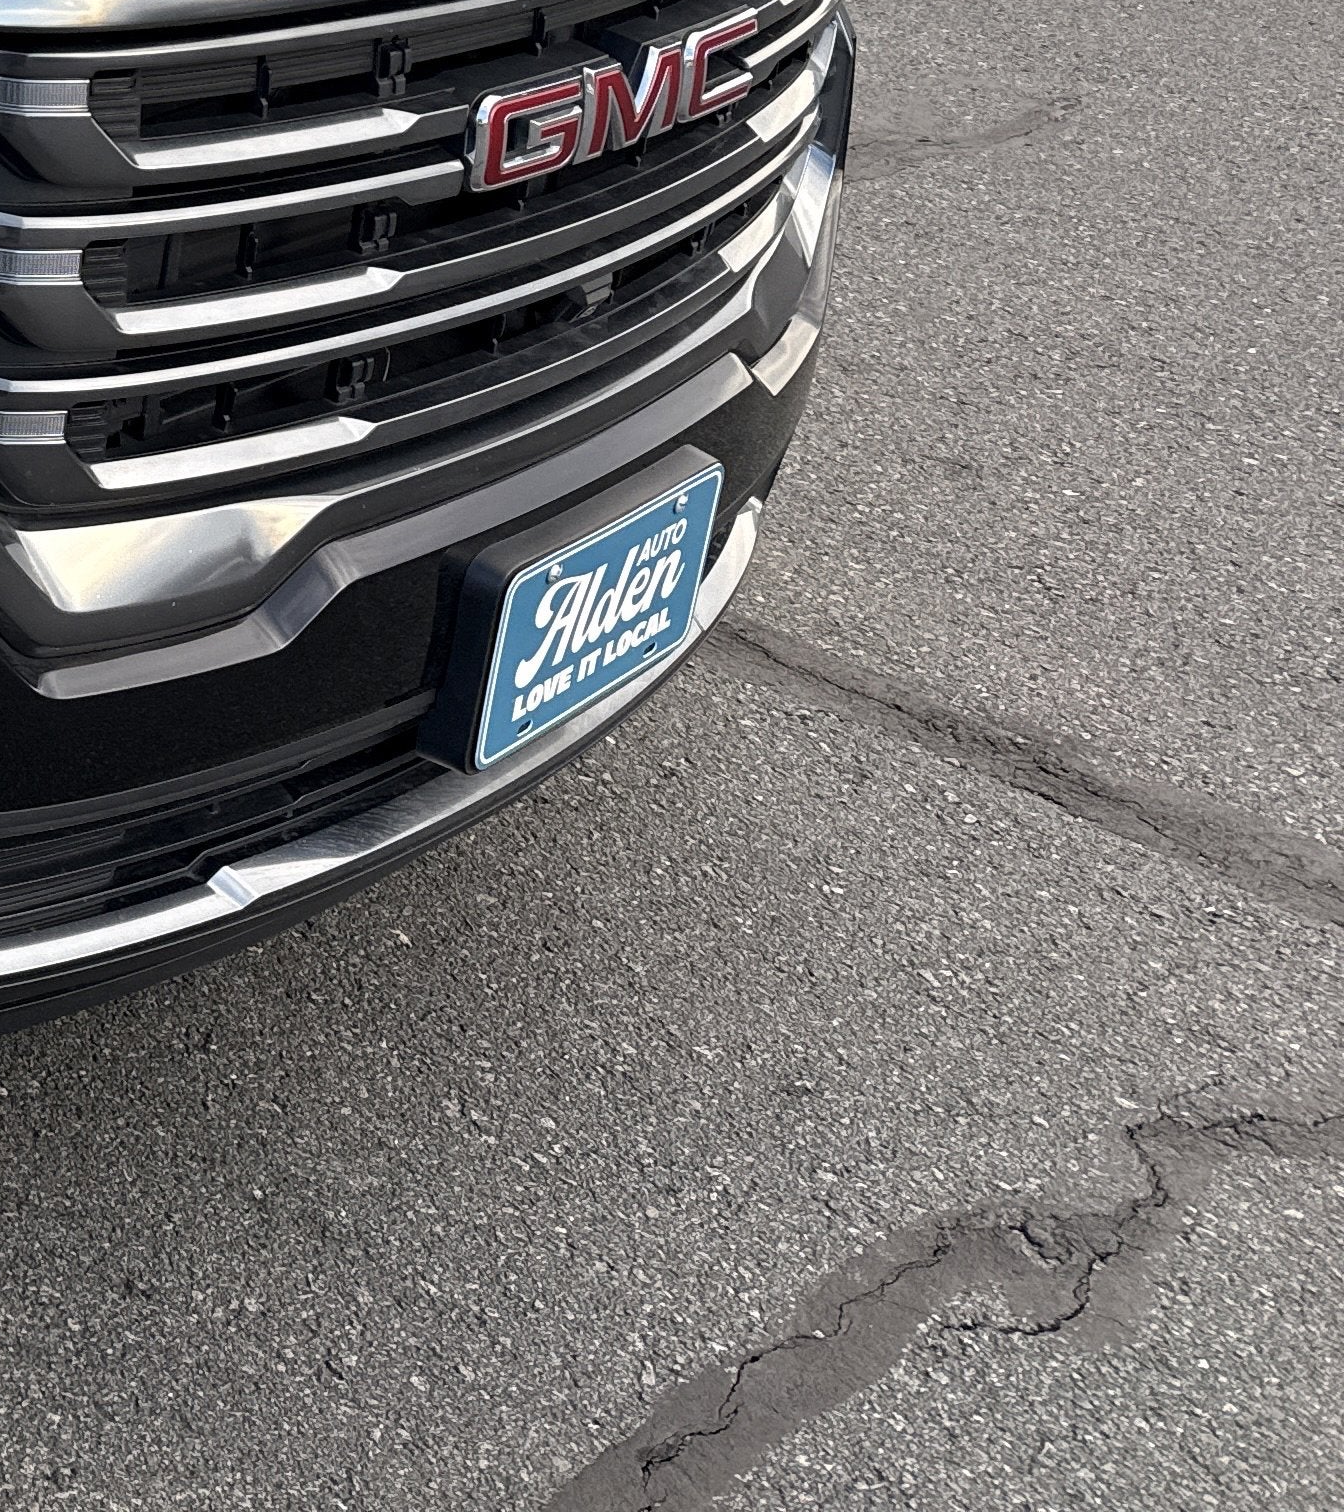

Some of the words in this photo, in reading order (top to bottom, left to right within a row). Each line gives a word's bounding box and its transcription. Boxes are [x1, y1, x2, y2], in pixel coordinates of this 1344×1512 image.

[465, 8, 758, 192] GMC
[636, 518, 687, 566] AUTO
[512, 664, 574, 722] LOVE
[577, 648, 602, 682] IT
[603, 607, 671, 666] LOCAL
[514, 544, 685, 688] Alden
